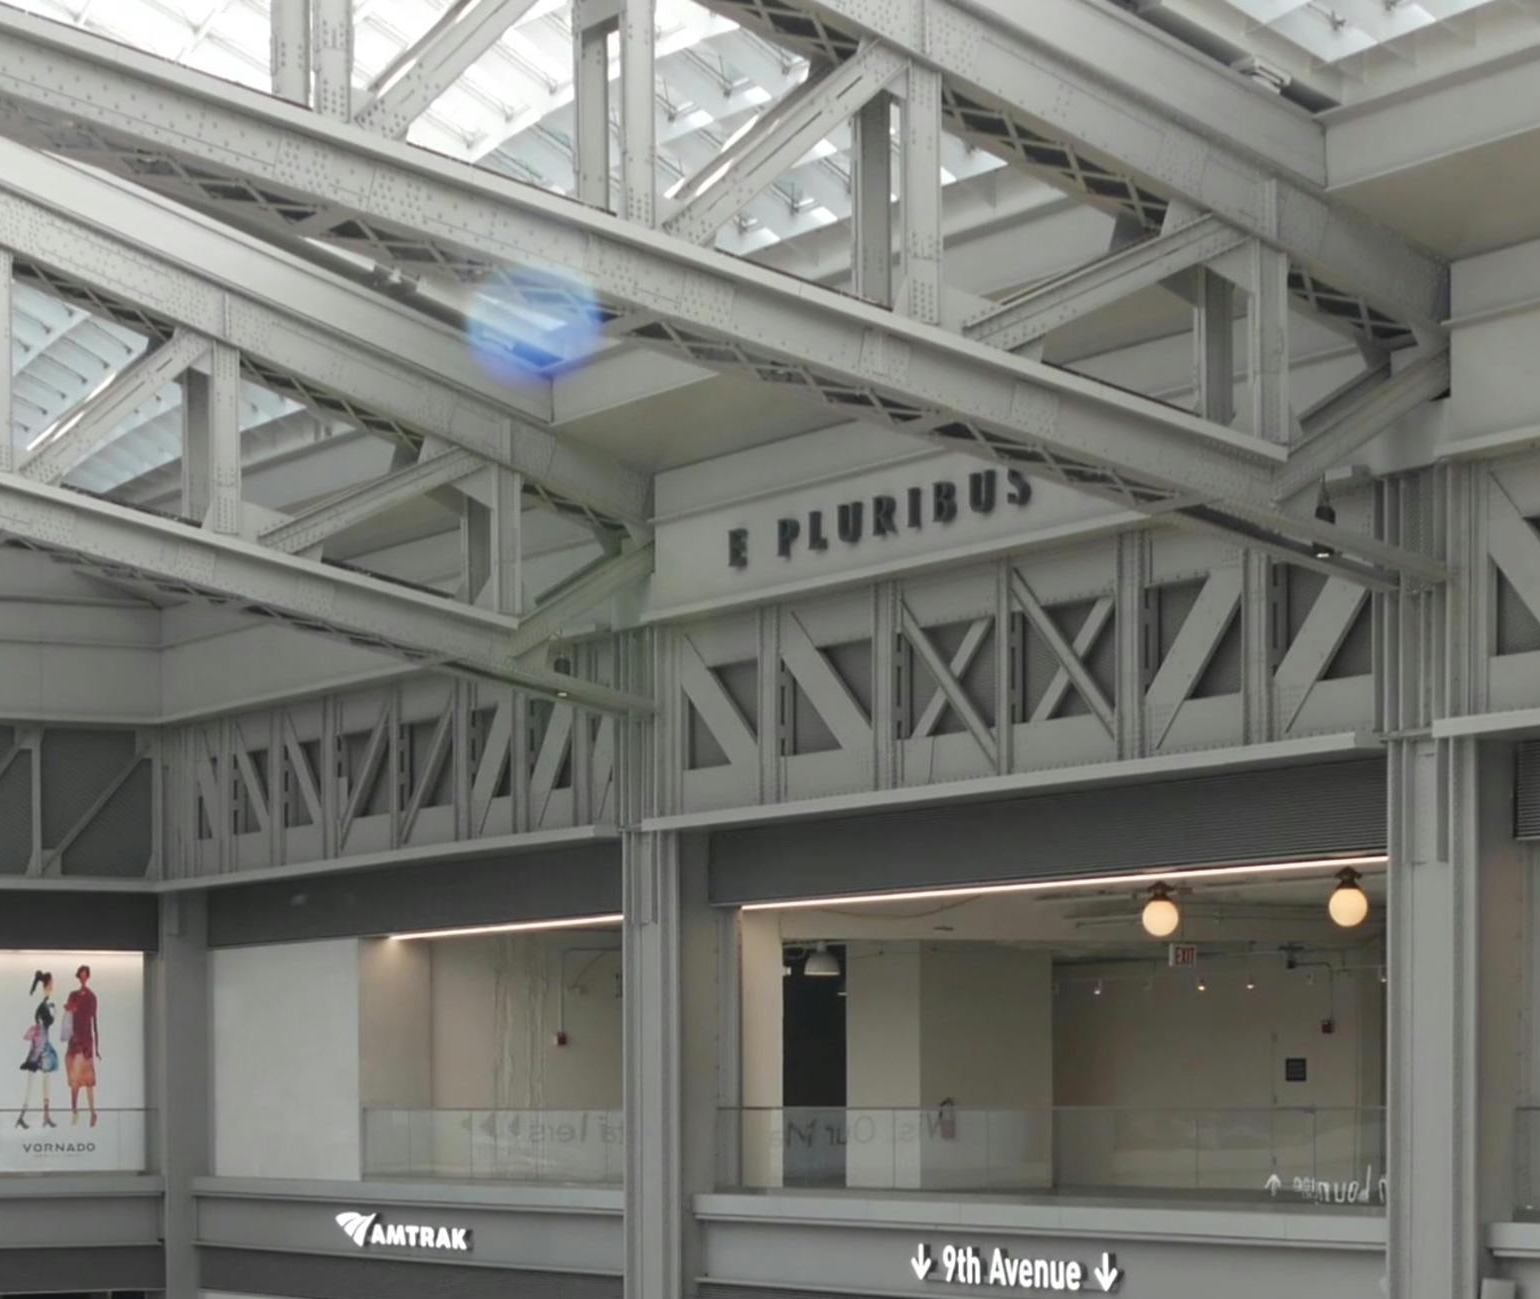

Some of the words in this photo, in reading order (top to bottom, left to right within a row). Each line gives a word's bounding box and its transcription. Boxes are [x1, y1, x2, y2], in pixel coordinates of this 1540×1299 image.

[730, 530, 746, 567] E
[777, 468, 1032, 558] PLURIBUS
[23, 1143, 95, 1152] VORNADO
[371, 1223, 468, 1250] AMTRAK
[943, 1245, 980, 1283] 9th
[990, 1248, 1080, 1290] Avenue
